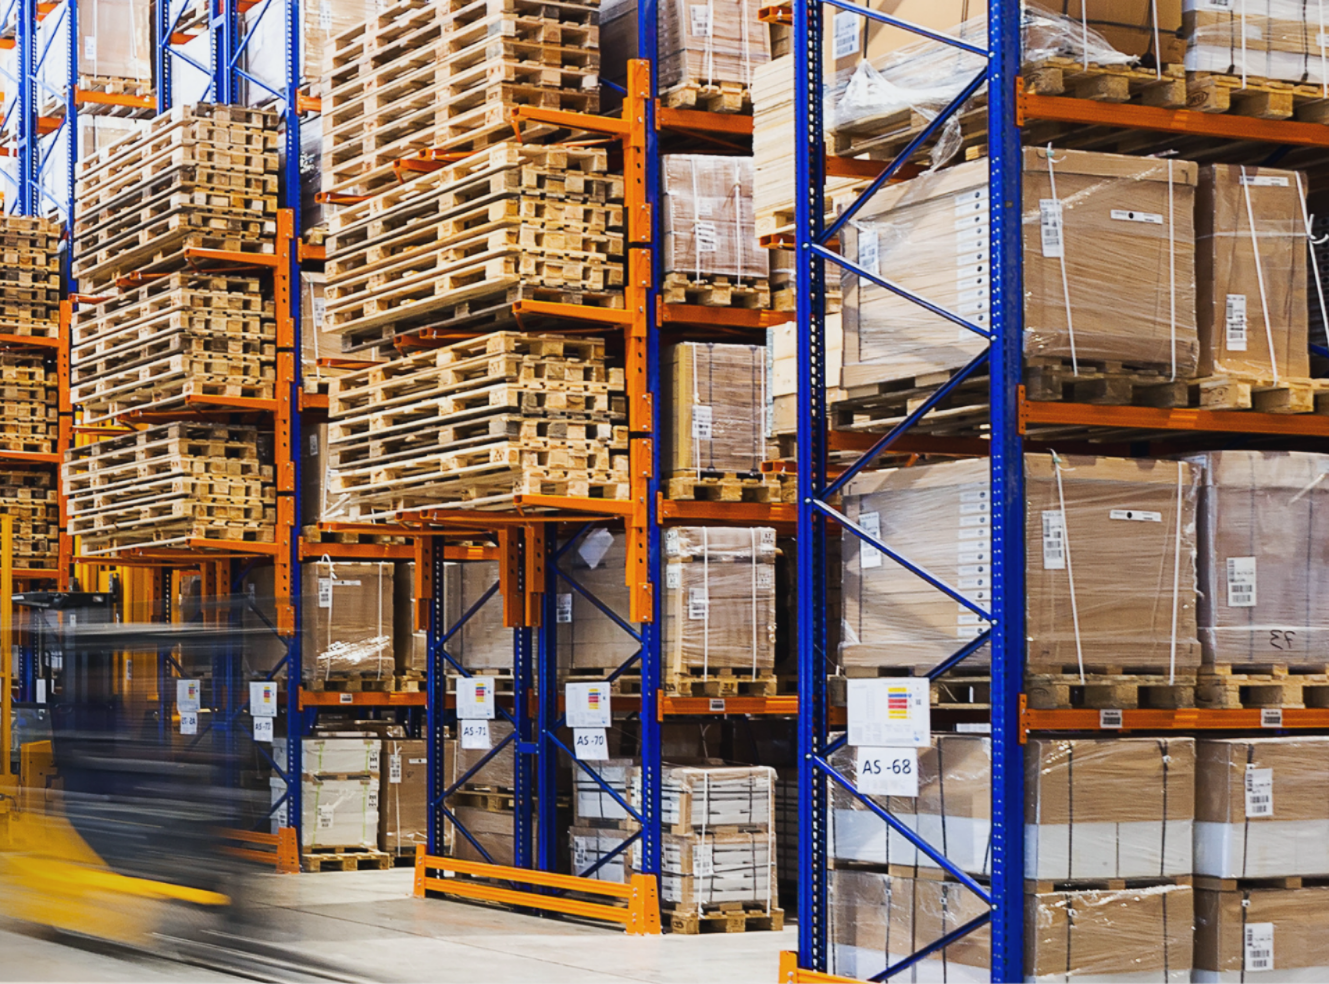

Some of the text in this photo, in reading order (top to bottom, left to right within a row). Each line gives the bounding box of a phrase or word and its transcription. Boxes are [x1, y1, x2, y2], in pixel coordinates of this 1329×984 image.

[463, 726, 474, 736] AS
[577, 735, 604, 746] AS -70
[862, 758, 912, 775] AS -68
